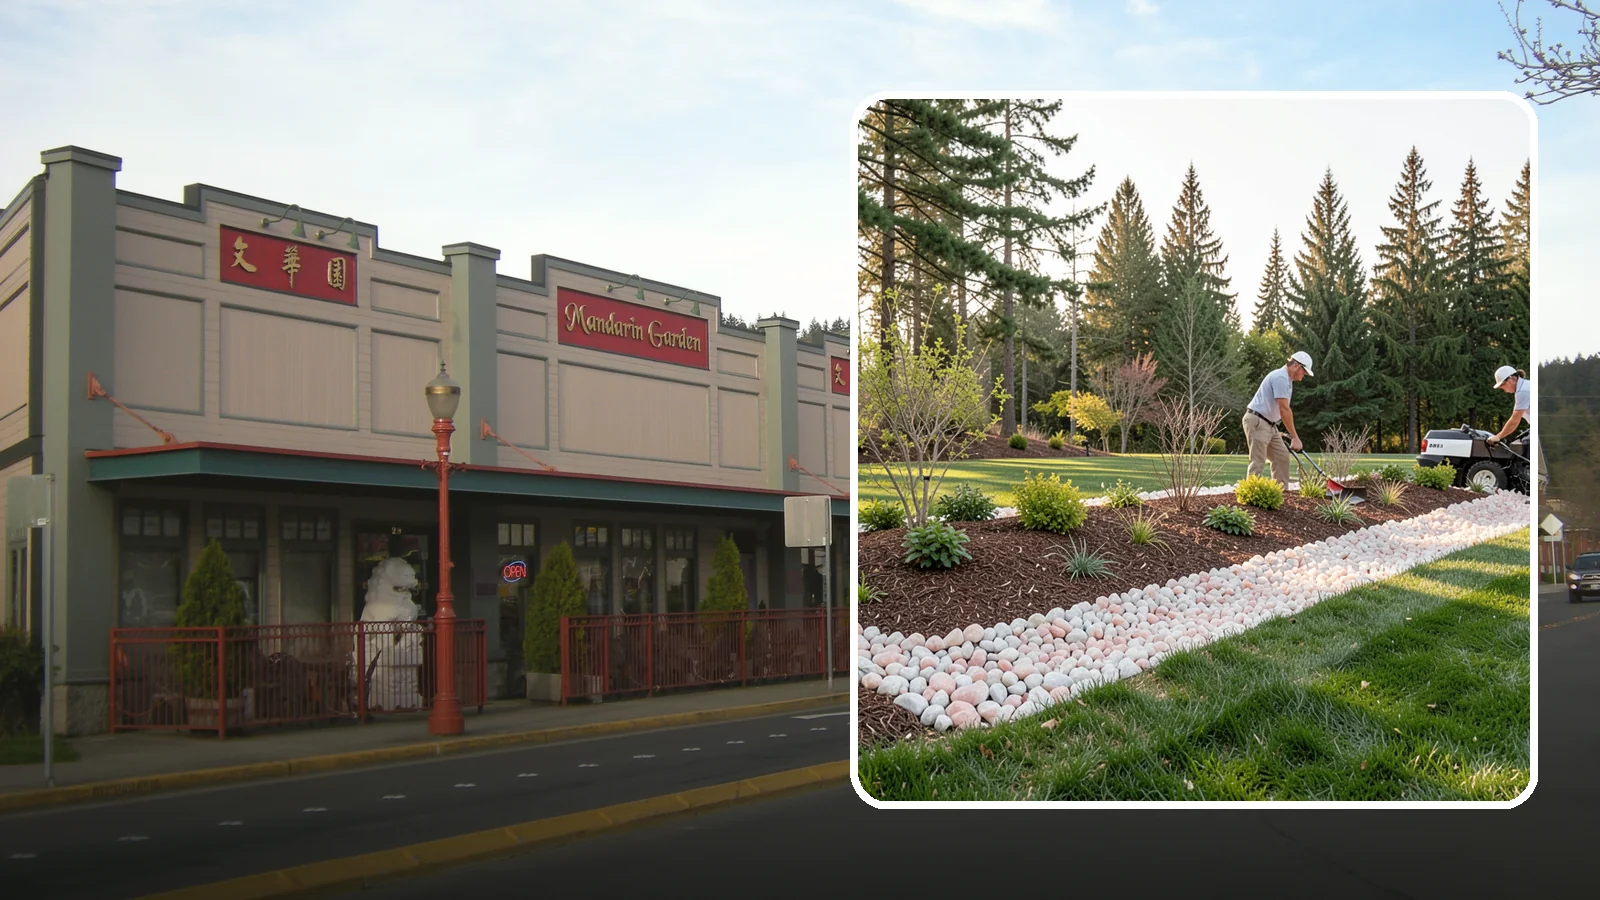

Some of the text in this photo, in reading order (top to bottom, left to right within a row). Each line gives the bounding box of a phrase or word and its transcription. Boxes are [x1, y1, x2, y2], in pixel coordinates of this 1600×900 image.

[230, 235, 346, 291] 文華園
[564, 302, 701, 352] Mandarin Garden
[503, 565, 527, 578] OPEN
